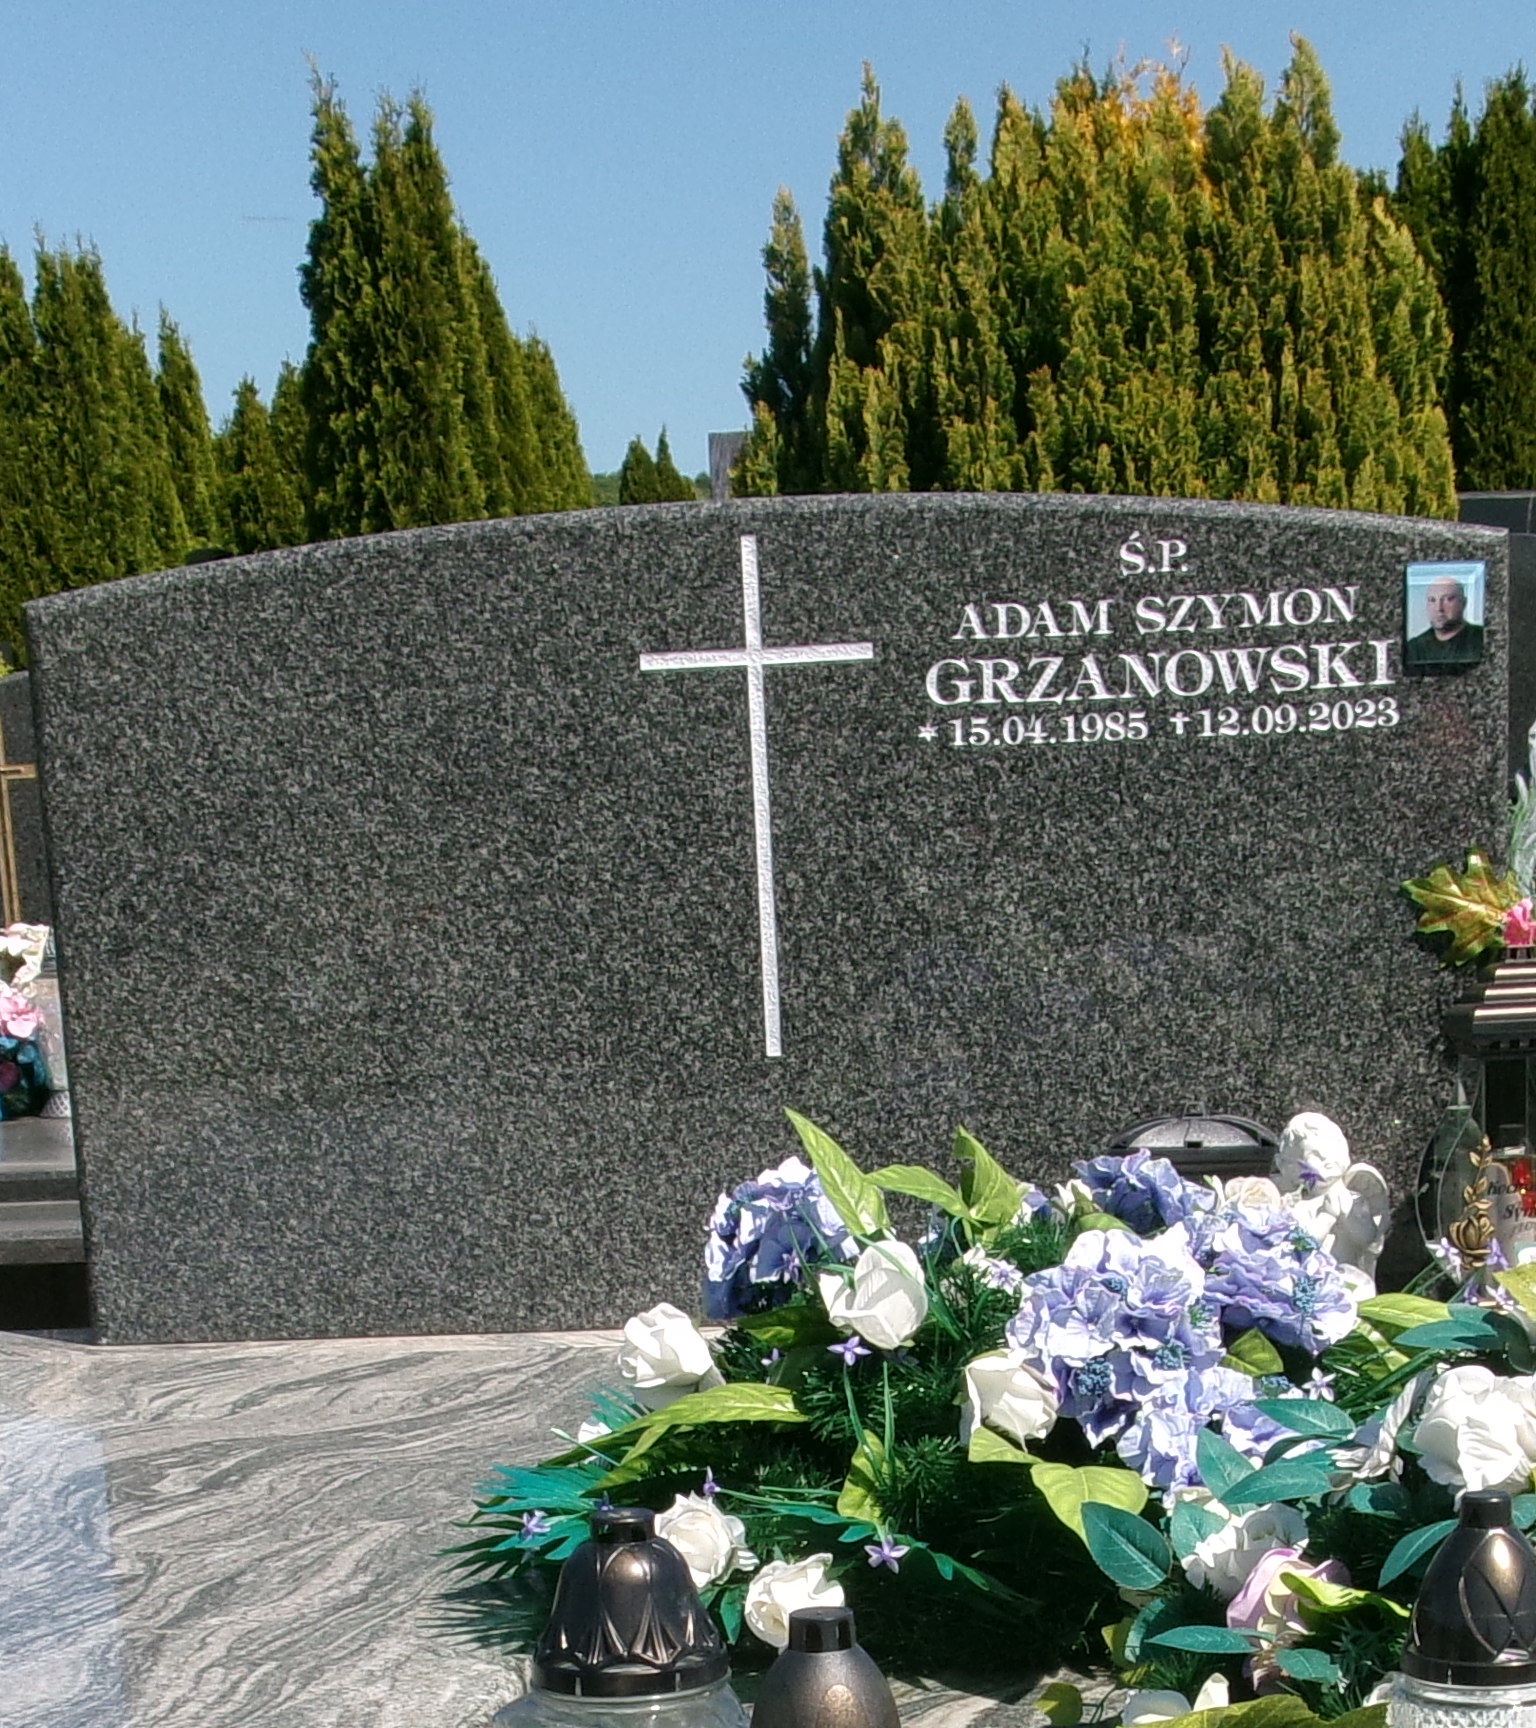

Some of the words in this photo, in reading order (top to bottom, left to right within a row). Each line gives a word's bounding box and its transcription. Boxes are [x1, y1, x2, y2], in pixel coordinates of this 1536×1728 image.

[1119, 530, 1189, 577] Ś.P.
[951, 599, 1115, 640] ADAM
[1135, 585, 1361, 635] SZYMON
[925, 639, 1396, 706] GRZANOWSKI
